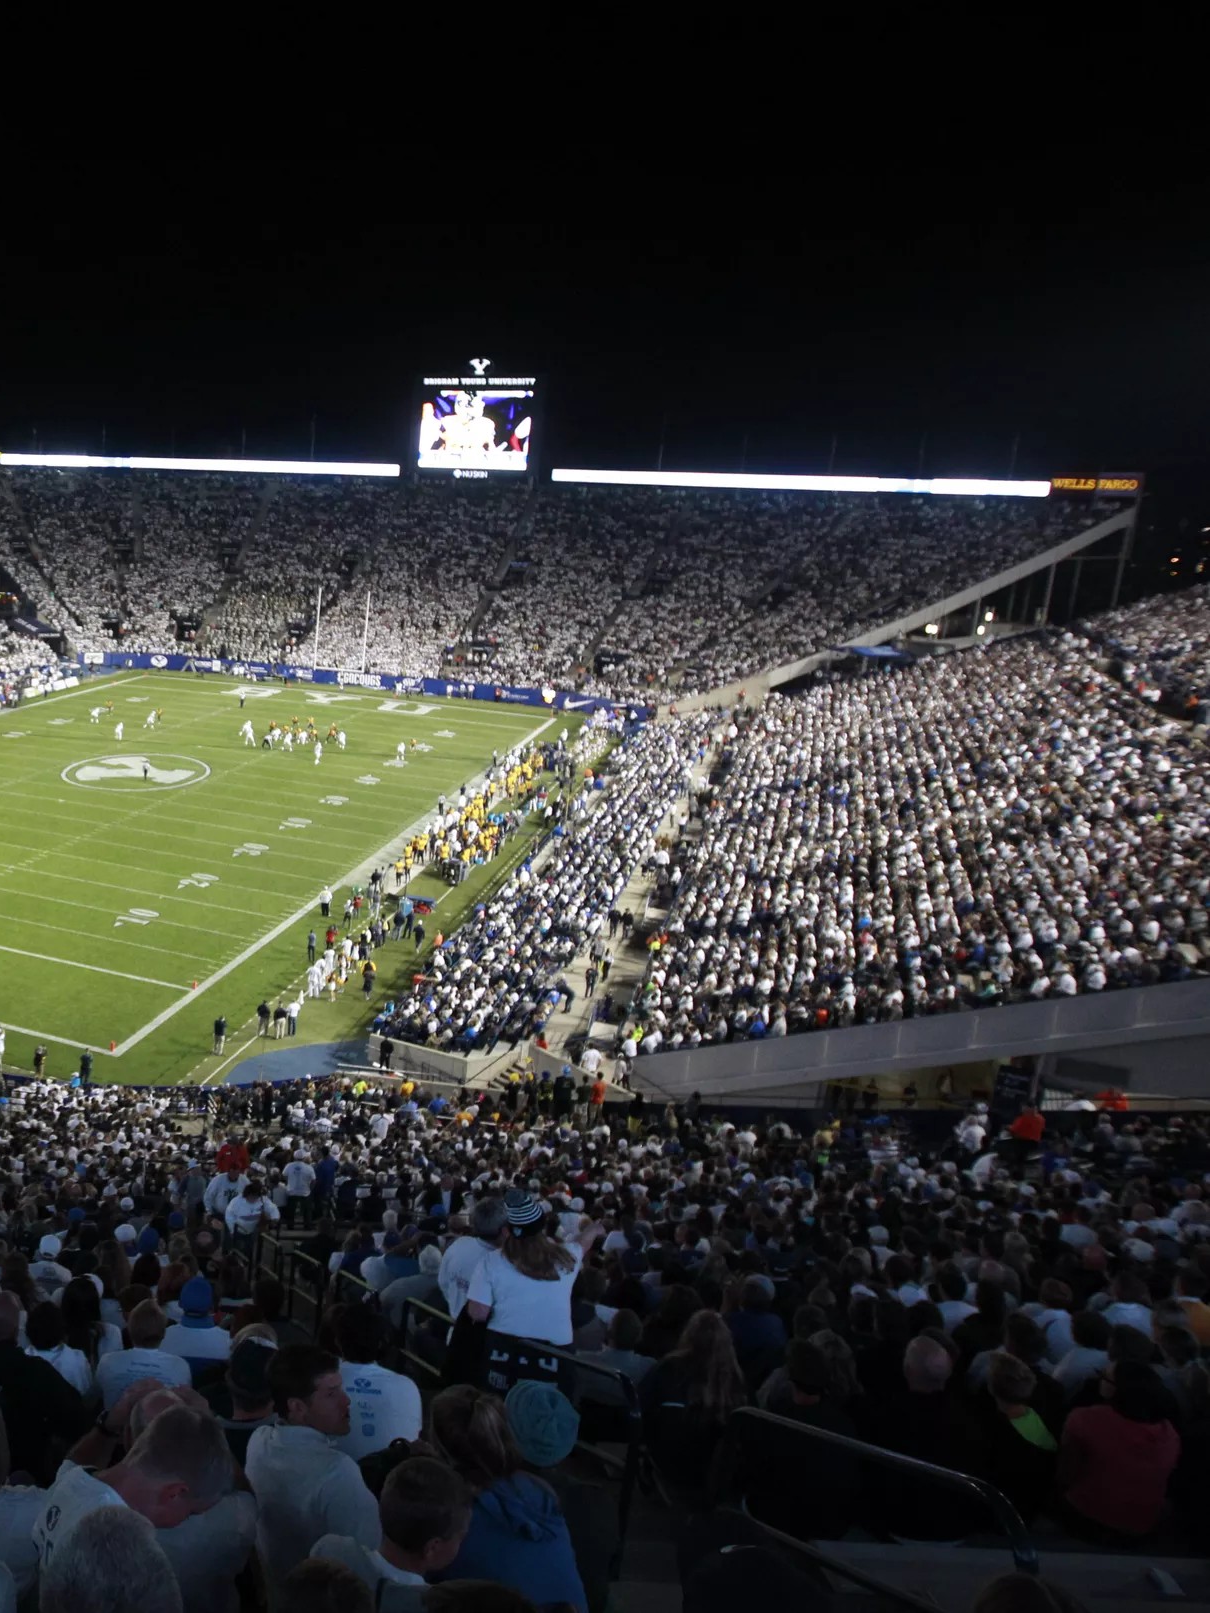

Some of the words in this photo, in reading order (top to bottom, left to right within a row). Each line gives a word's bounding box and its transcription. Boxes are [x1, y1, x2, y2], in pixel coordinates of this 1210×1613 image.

[423, 378, 459, 386] BRIGHAM
[460, 378, 487, 386] YOUNG
[488, 378, 536, 386] UNIVERSITY
[1052, 478, 1096, 490] WELLS
[1098, 478, 1139, 491] FARGO
